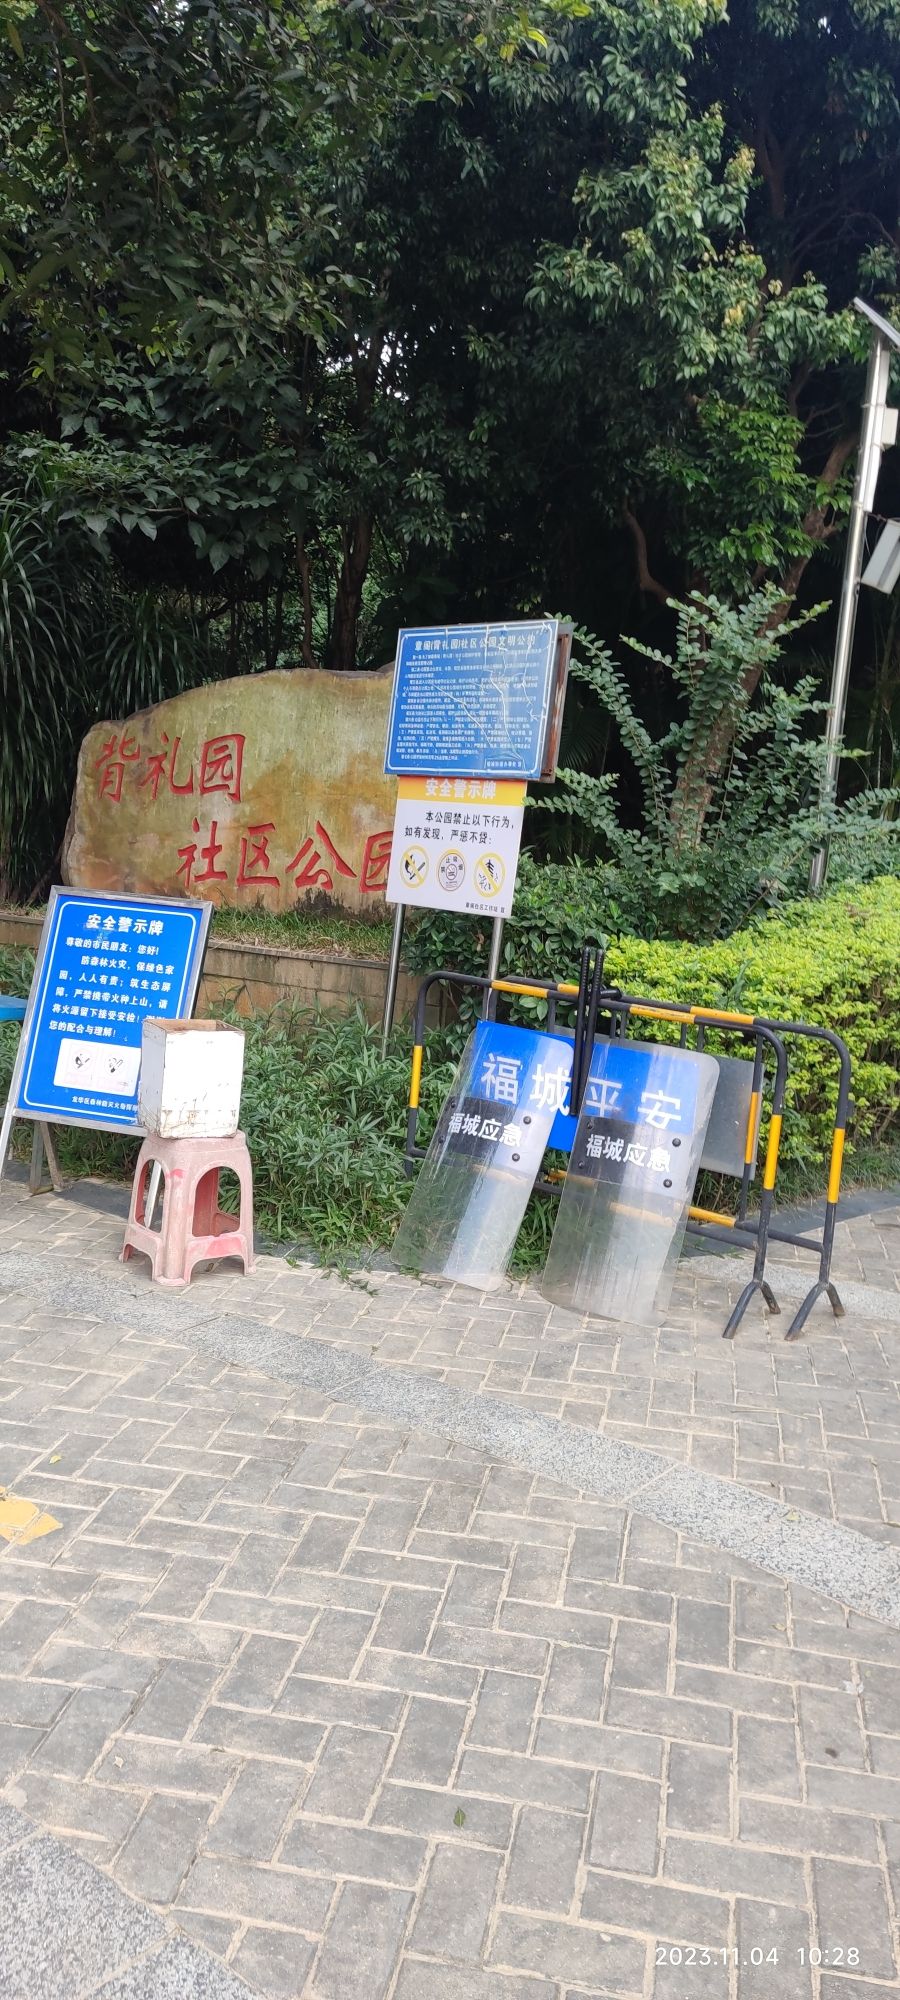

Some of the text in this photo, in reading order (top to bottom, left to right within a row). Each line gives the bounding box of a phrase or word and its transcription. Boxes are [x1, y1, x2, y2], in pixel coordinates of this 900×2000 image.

[95, 729, 246, 803] 背礼园
[426, 778, 496, 799] 安全警示牌
[86, 914, 164, 936] 安全警示牌
[448, 1113, 523, 1147] 福城应急
[586, 1134, 672, 1173] 福城应急
